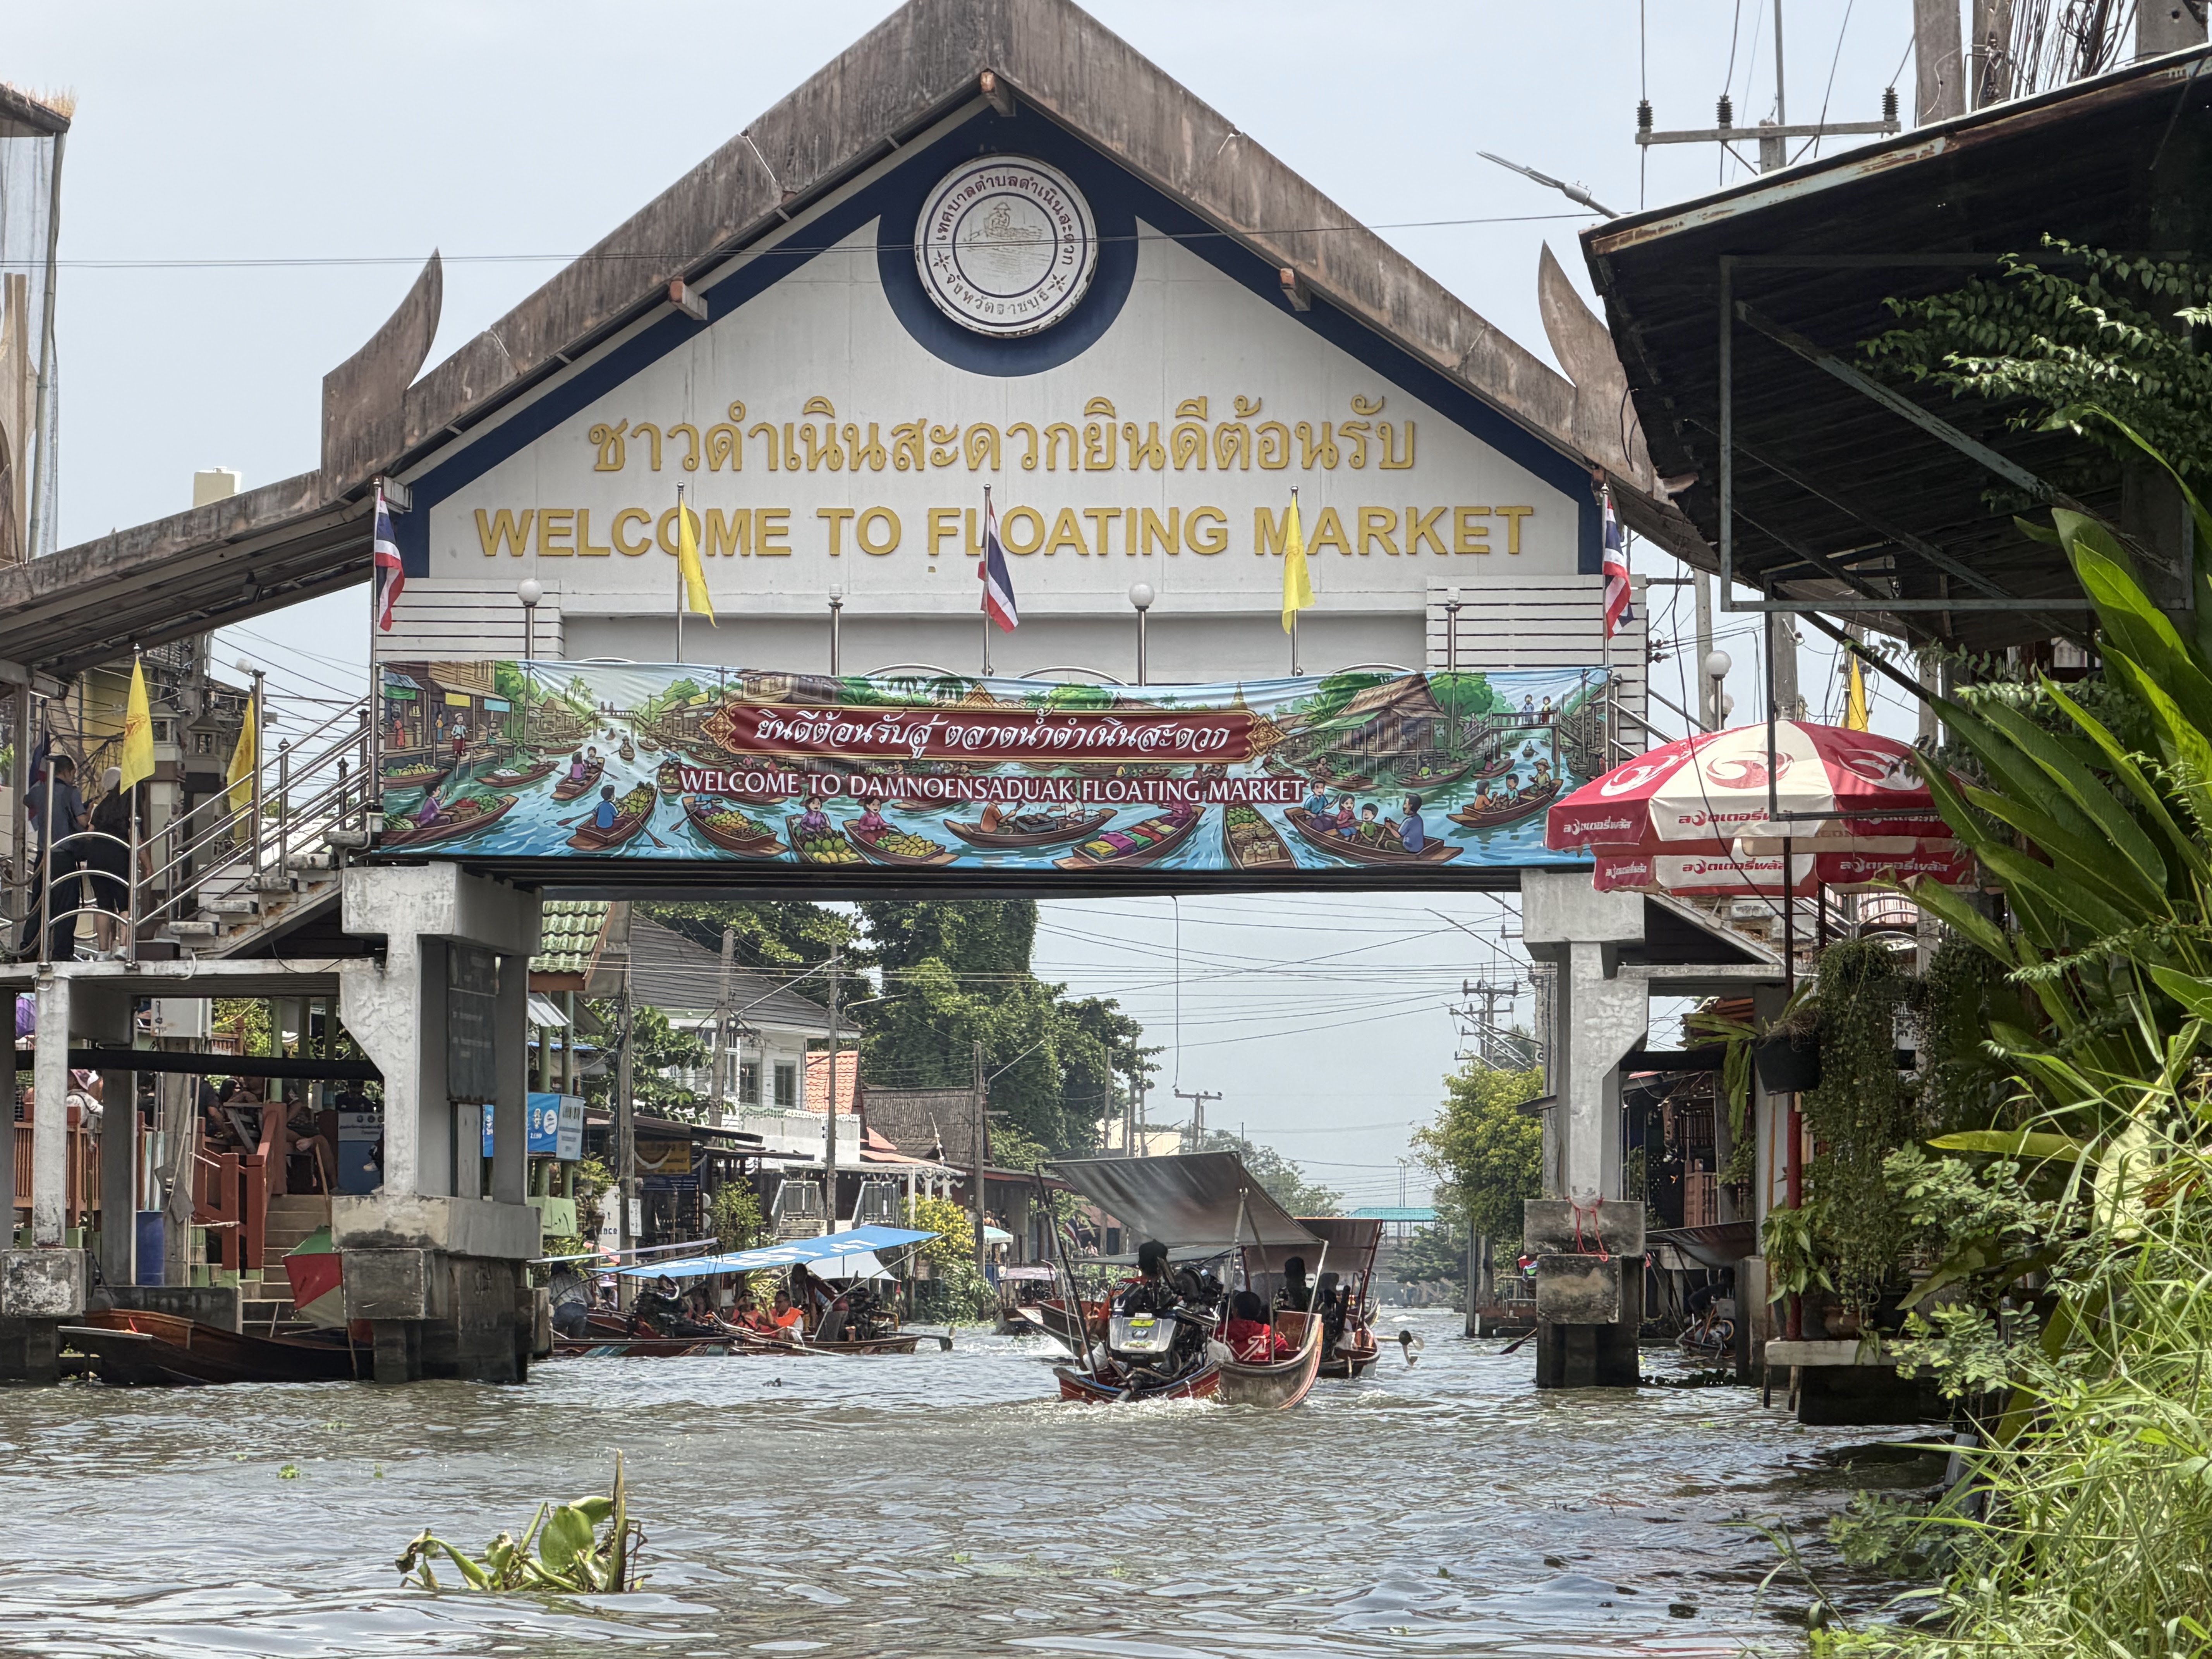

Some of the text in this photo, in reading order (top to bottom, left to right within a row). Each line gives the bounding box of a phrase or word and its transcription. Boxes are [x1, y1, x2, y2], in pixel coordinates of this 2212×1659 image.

[589, 395, 1414, 472] ชาวดำเนินสะดวกยินดีต้อนรับ
[474, 505, 1534, 556] WELCOME TO FLOATING MARKET
[754, 706, 1230, 759] ยินดีต้อนรับสู่ ตลาดน้ำดำเนินสะดวก
[680, 770, 1305, 801] WELCOME TO DAMNOENSADUAK FLOATING MARKET
